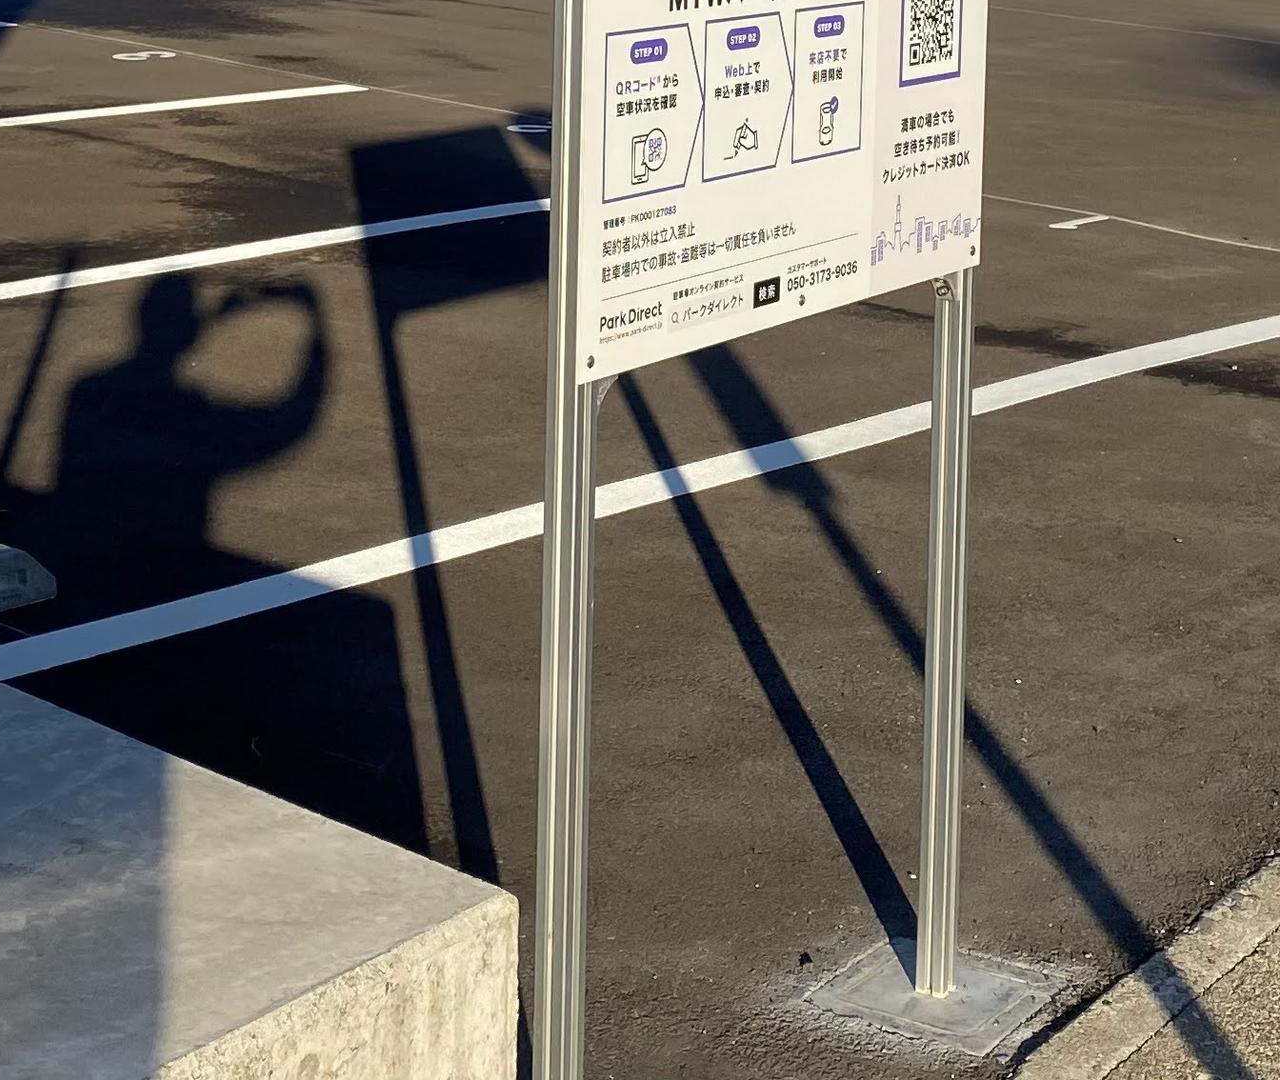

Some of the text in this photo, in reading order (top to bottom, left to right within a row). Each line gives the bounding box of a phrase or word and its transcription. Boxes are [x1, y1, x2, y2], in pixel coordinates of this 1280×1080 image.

[817, 21, 841, 33] STEP 03
[730, 33, 757, 45] STEP 02
[634, 46, 663, 58] STEP 01
[809, 48, 847, 67] 来店不要で
[724, 61, 761, 79] Web上で
[812, 66, 843, 85] 利用開始
[714, 78, 770, 101] 申込・審査・契約
[616, 93, 677, 118] 空車状況を確認
[900, 109, 955, 133] 満車の場合でも
[882, 150, 971, 185] クレジットカード決済OK
[602, 221, 696, 258] 契約者以外は立入禁止
[787, 260, 858, 292] 050-3173-9036
[599, 301, 663, 333] Park Direct
[682, 292, 744, 322] パークダイレクト
